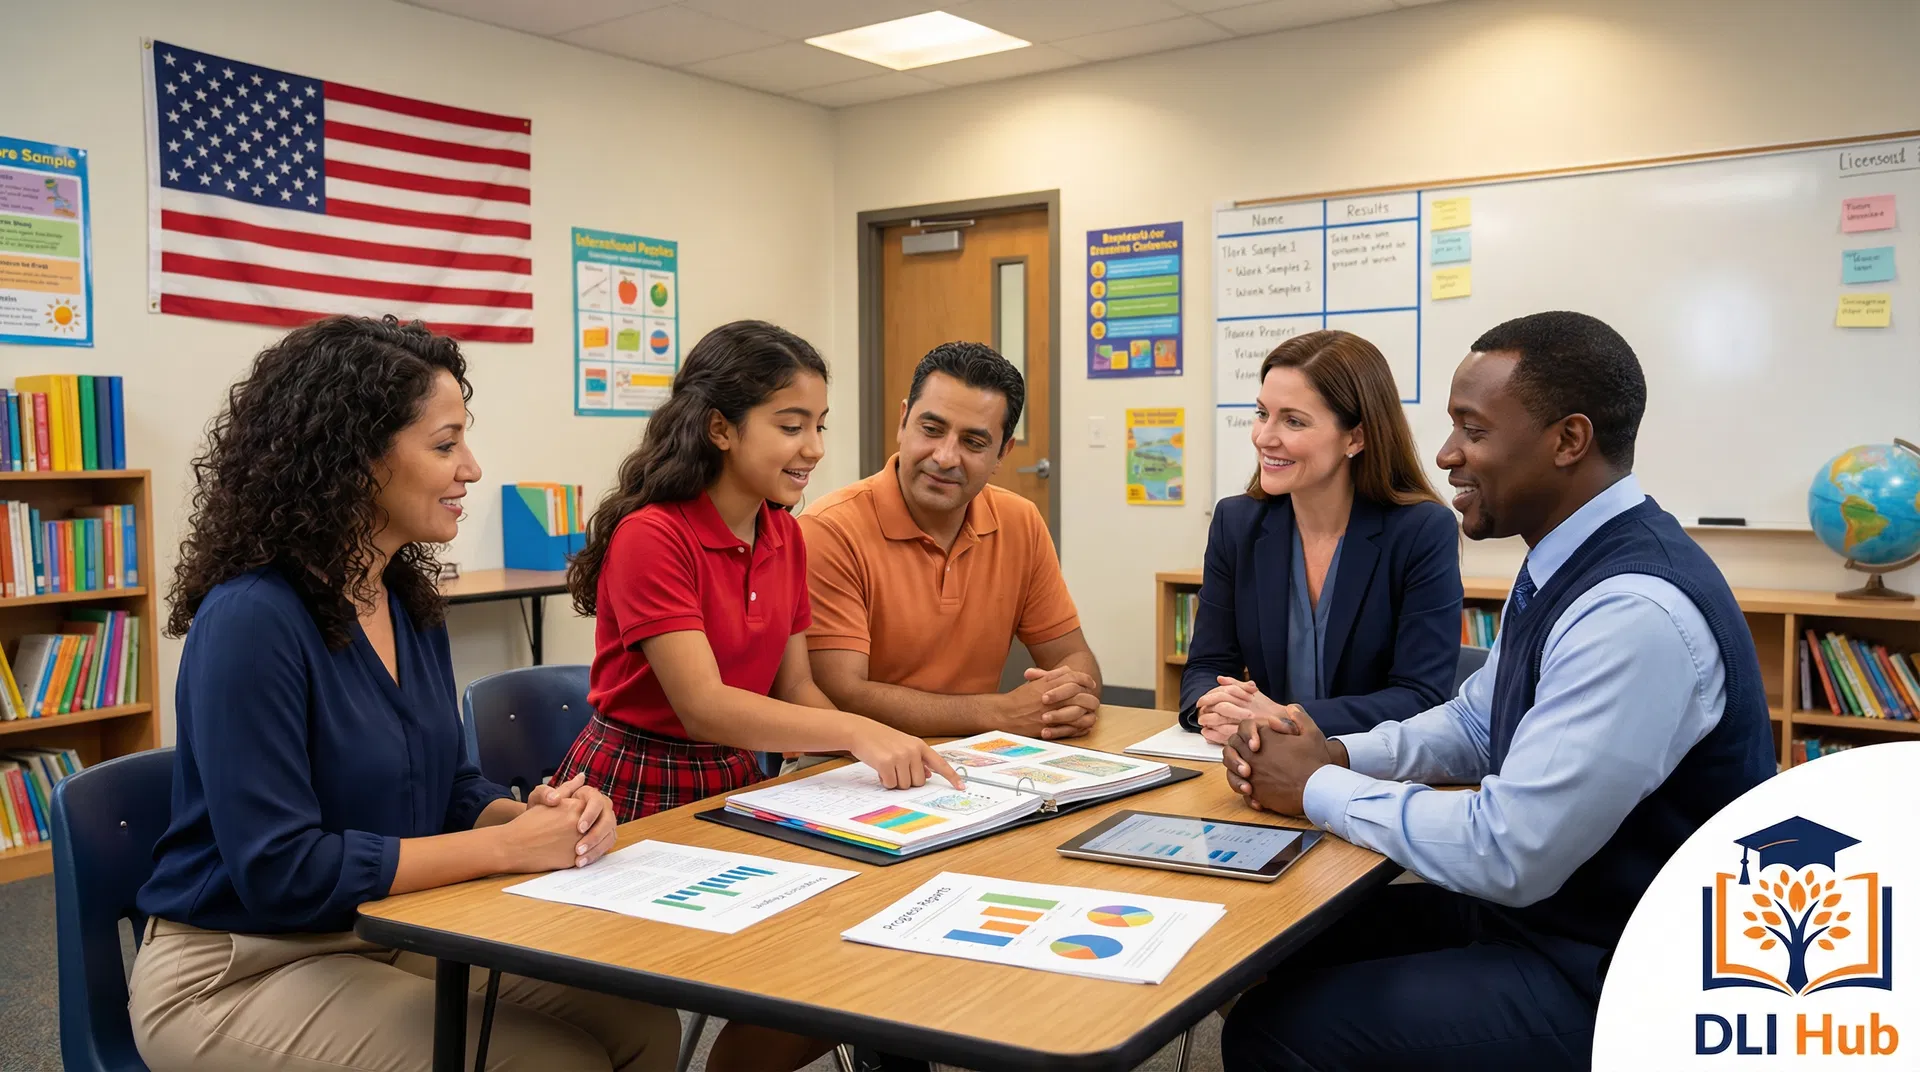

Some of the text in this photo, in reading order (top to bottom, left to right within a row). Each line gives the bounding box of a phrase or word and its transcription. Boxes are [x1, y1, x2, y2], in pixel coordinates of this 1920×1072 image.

[0, 149, 76, 168] re Sample
[1347, 202, 1389, 217] Results
[1252, 214, 1284, 226] Name
[1252, 243, 1287, 258] Sample
[882, 887, 951, 930] Progress Reports
